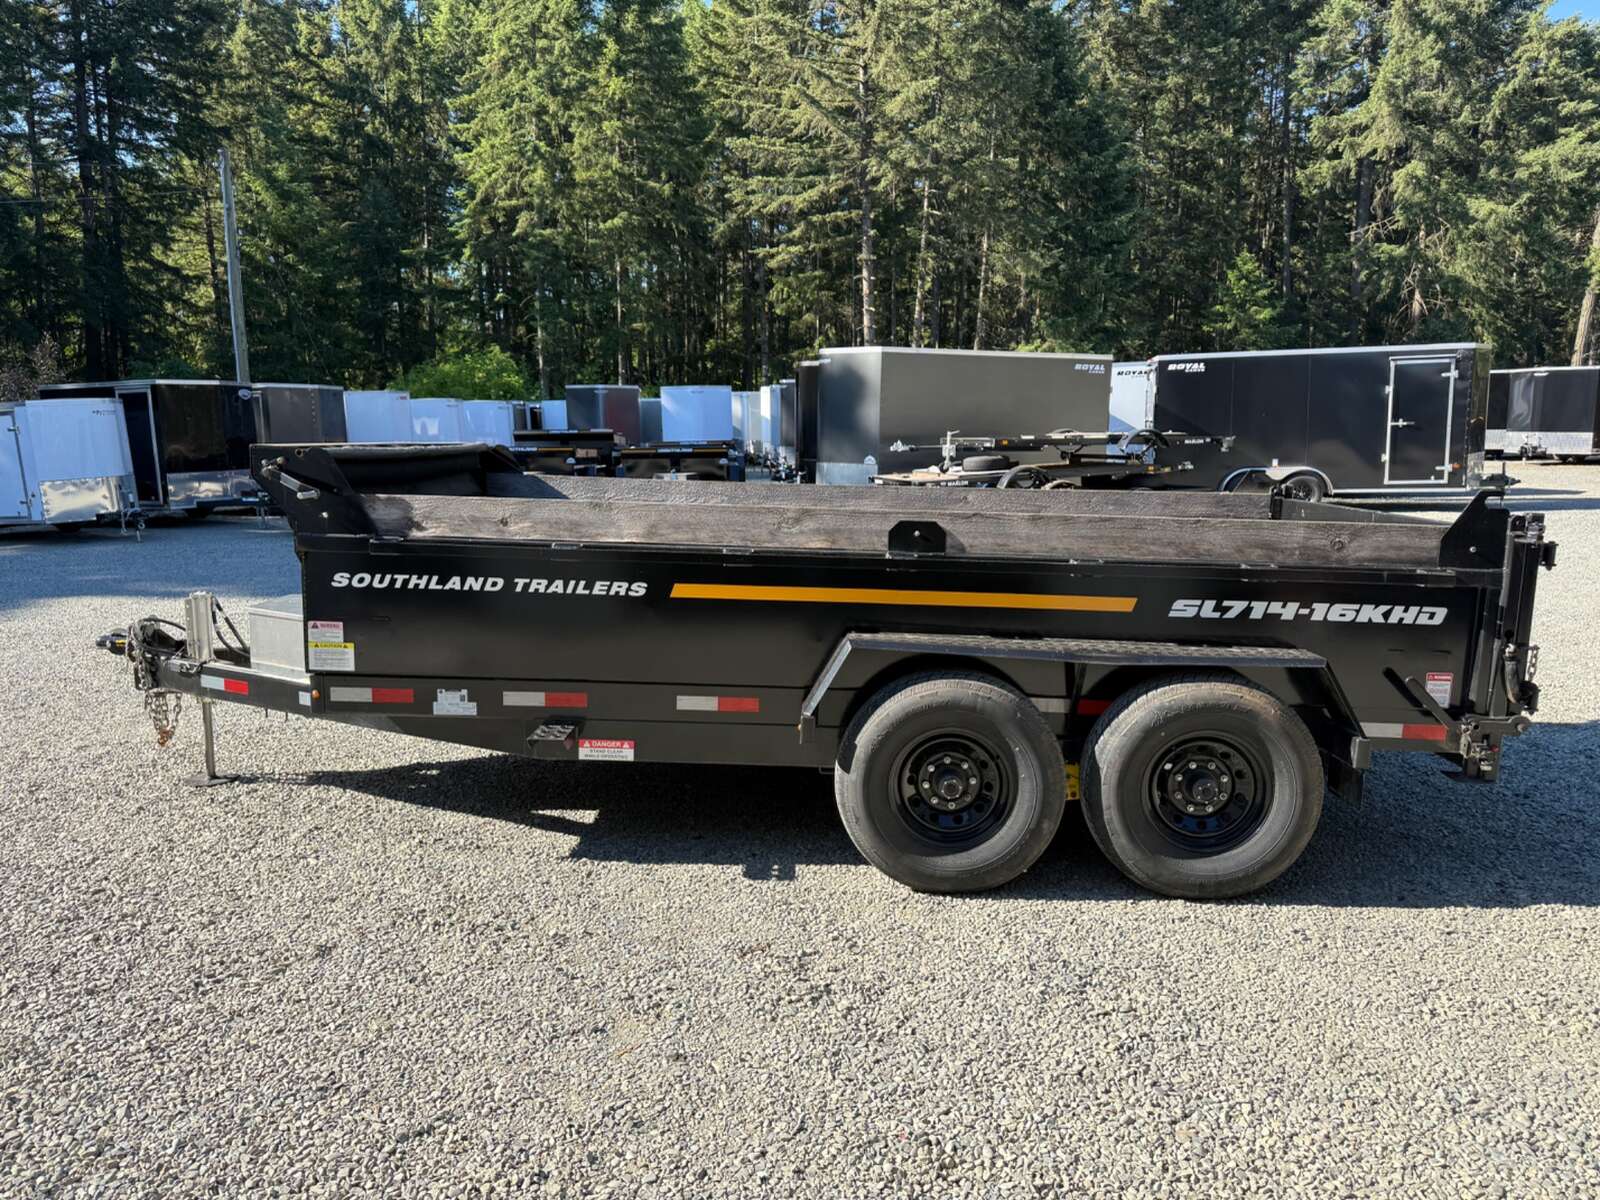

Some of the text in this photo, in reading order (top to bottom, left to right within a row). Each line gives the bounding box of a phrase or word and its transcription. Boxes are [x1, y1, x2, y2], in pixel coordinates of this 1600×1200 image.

[1074, 363, 1105, 371] ROYAL
[1168, 363, 1205, 371] ROYAL
[331, 573, 648, 597] SOUTHLAND TRAILERS
[1168, 599, 1448, 626] SL714-16KHD
